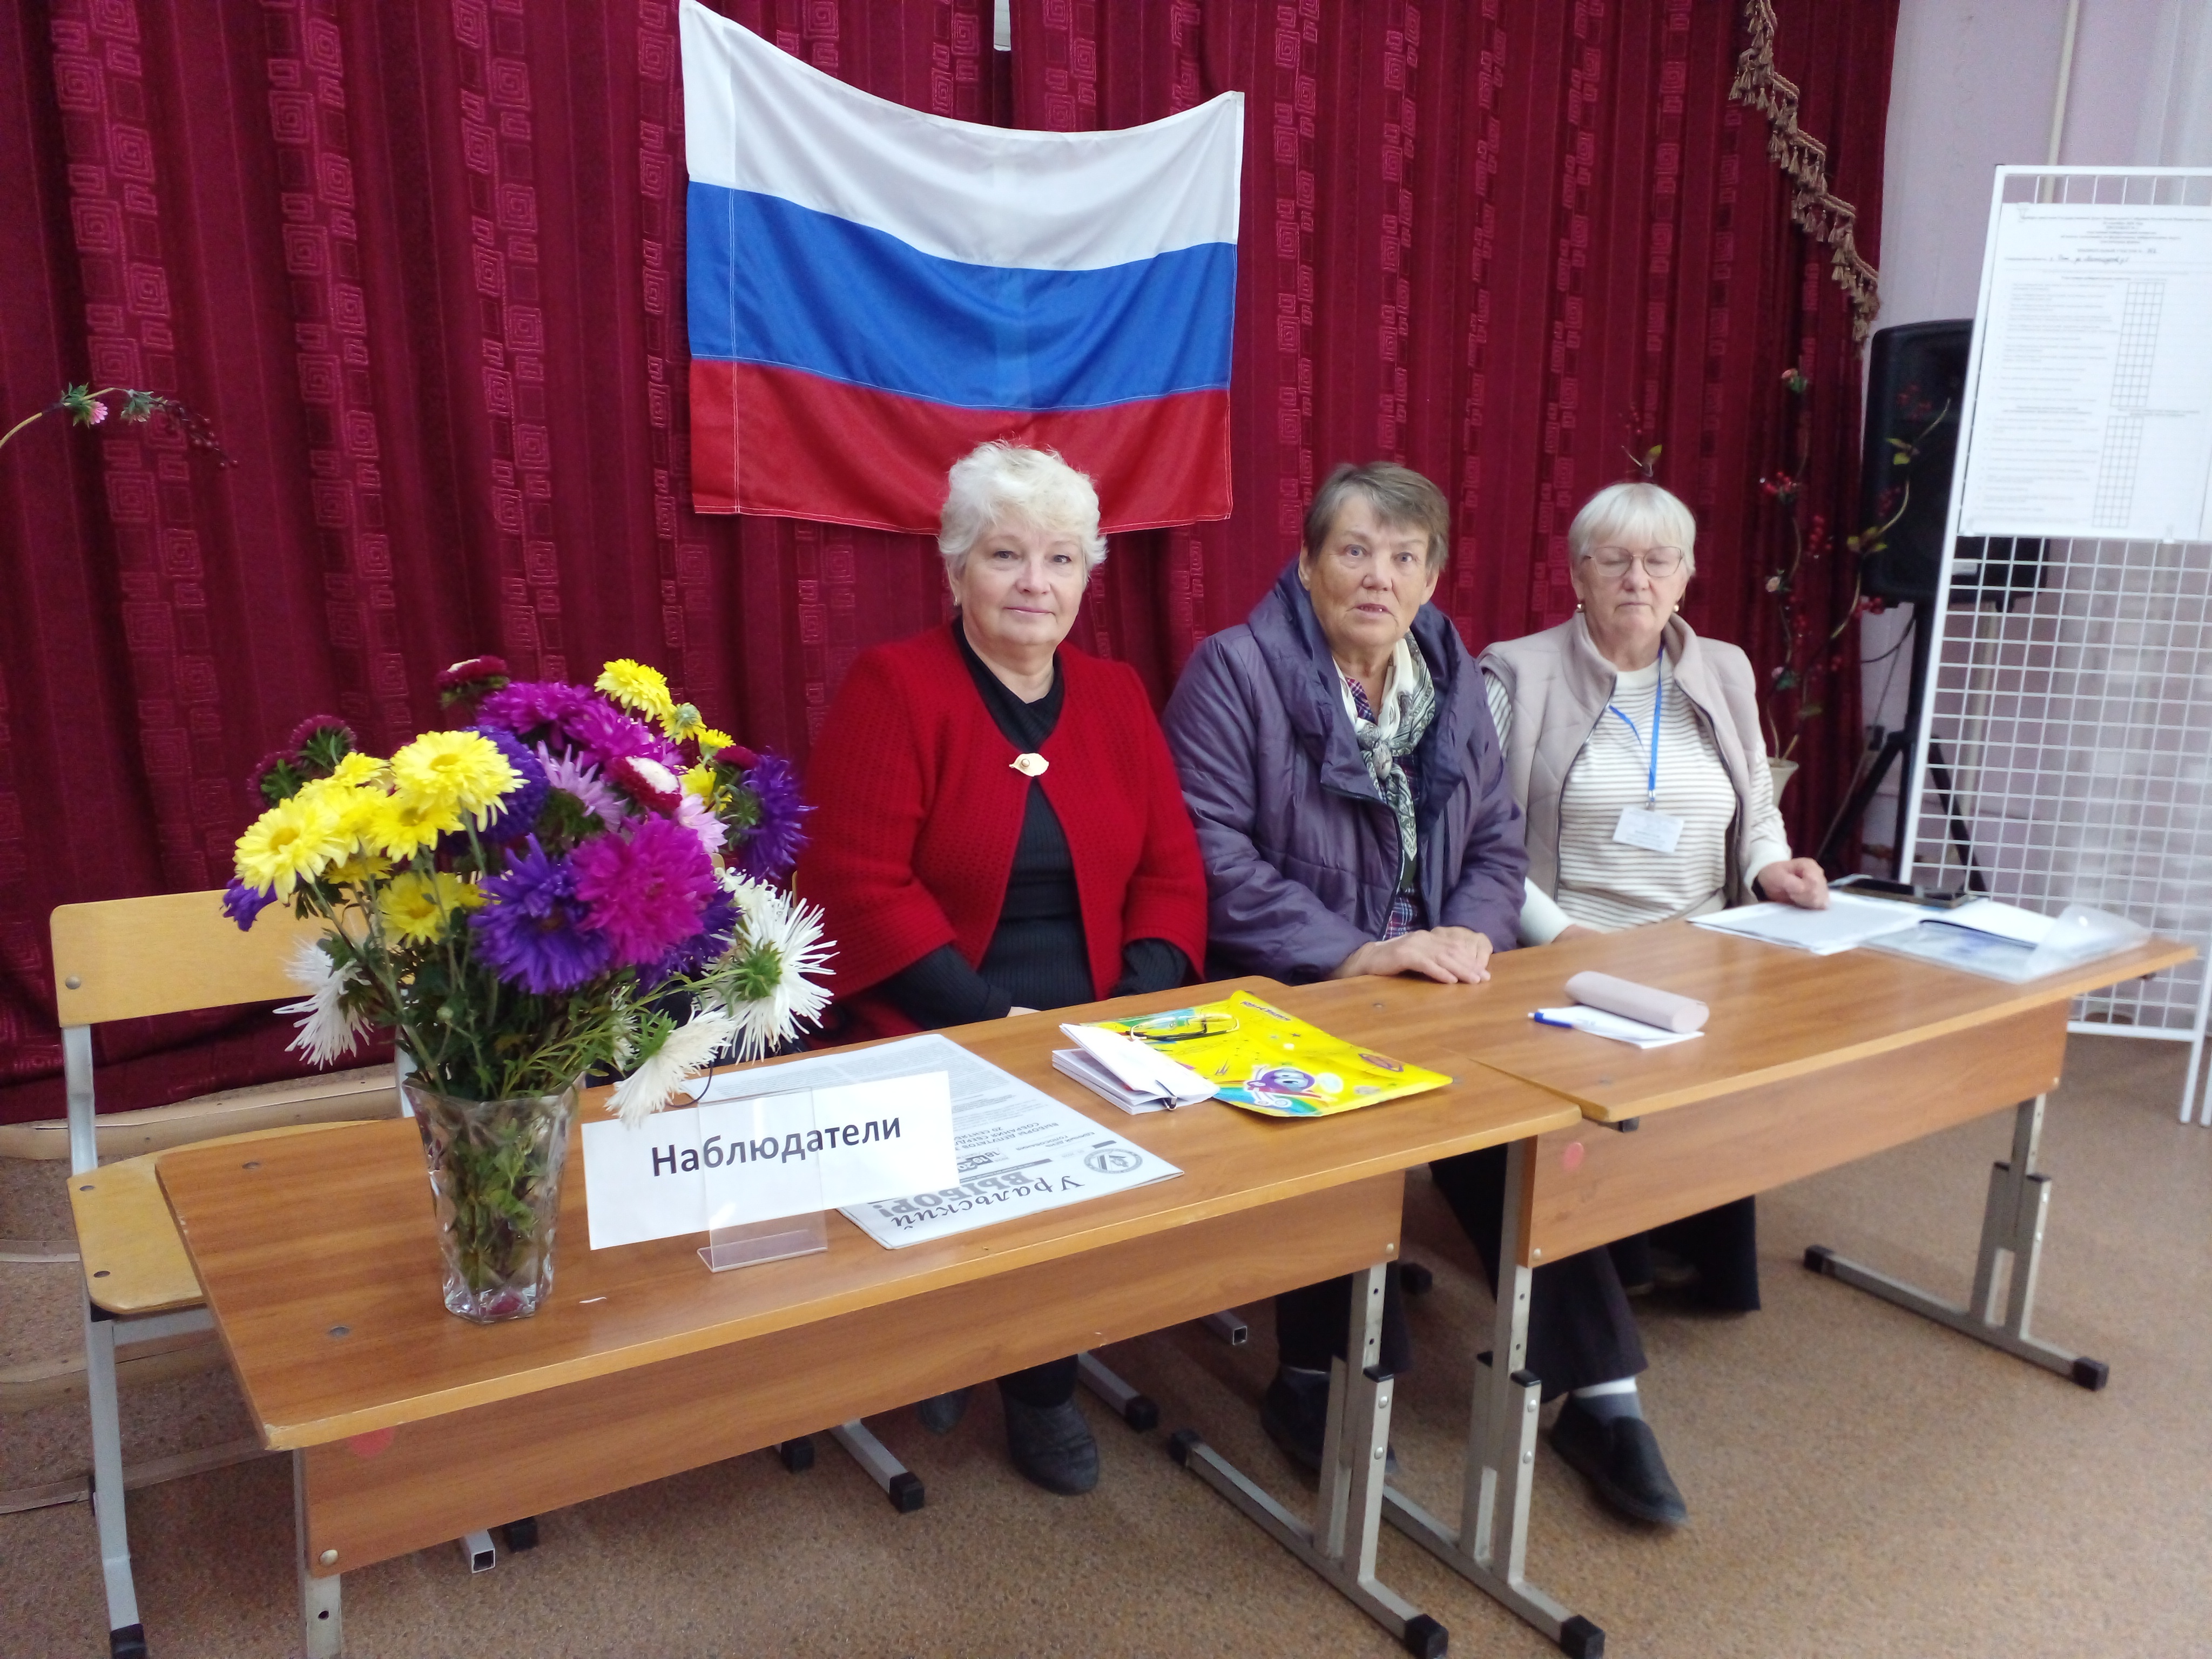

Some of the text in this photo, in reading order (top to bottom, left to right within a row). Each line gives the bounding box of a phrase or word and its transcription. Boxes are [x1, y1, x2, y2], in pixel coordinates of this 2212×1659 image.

[961, 1122, 1059, 1149] ВЫБОРЫ ДЕПУТАТОВ
[991, 1122, 1040, 1139] СОБРАНИЯ
[651, 1116, 901, 1177] Наблюдатели
[1015, 1135, 1069, 1151] ГОЛОСОВАНИЯ
[1045, 1131, 1096, 1148] ЕДИНЫЙ ДЕНЬ
[972, 1155, 989, 1164] 19
[984, 1148, 1001, 1157] 18
[957, 1162, 976, 1171] 20
[872, 1171, 1035, 1218] ВЫБОР!
[891, 1175, 1085, 1231] Уральский
